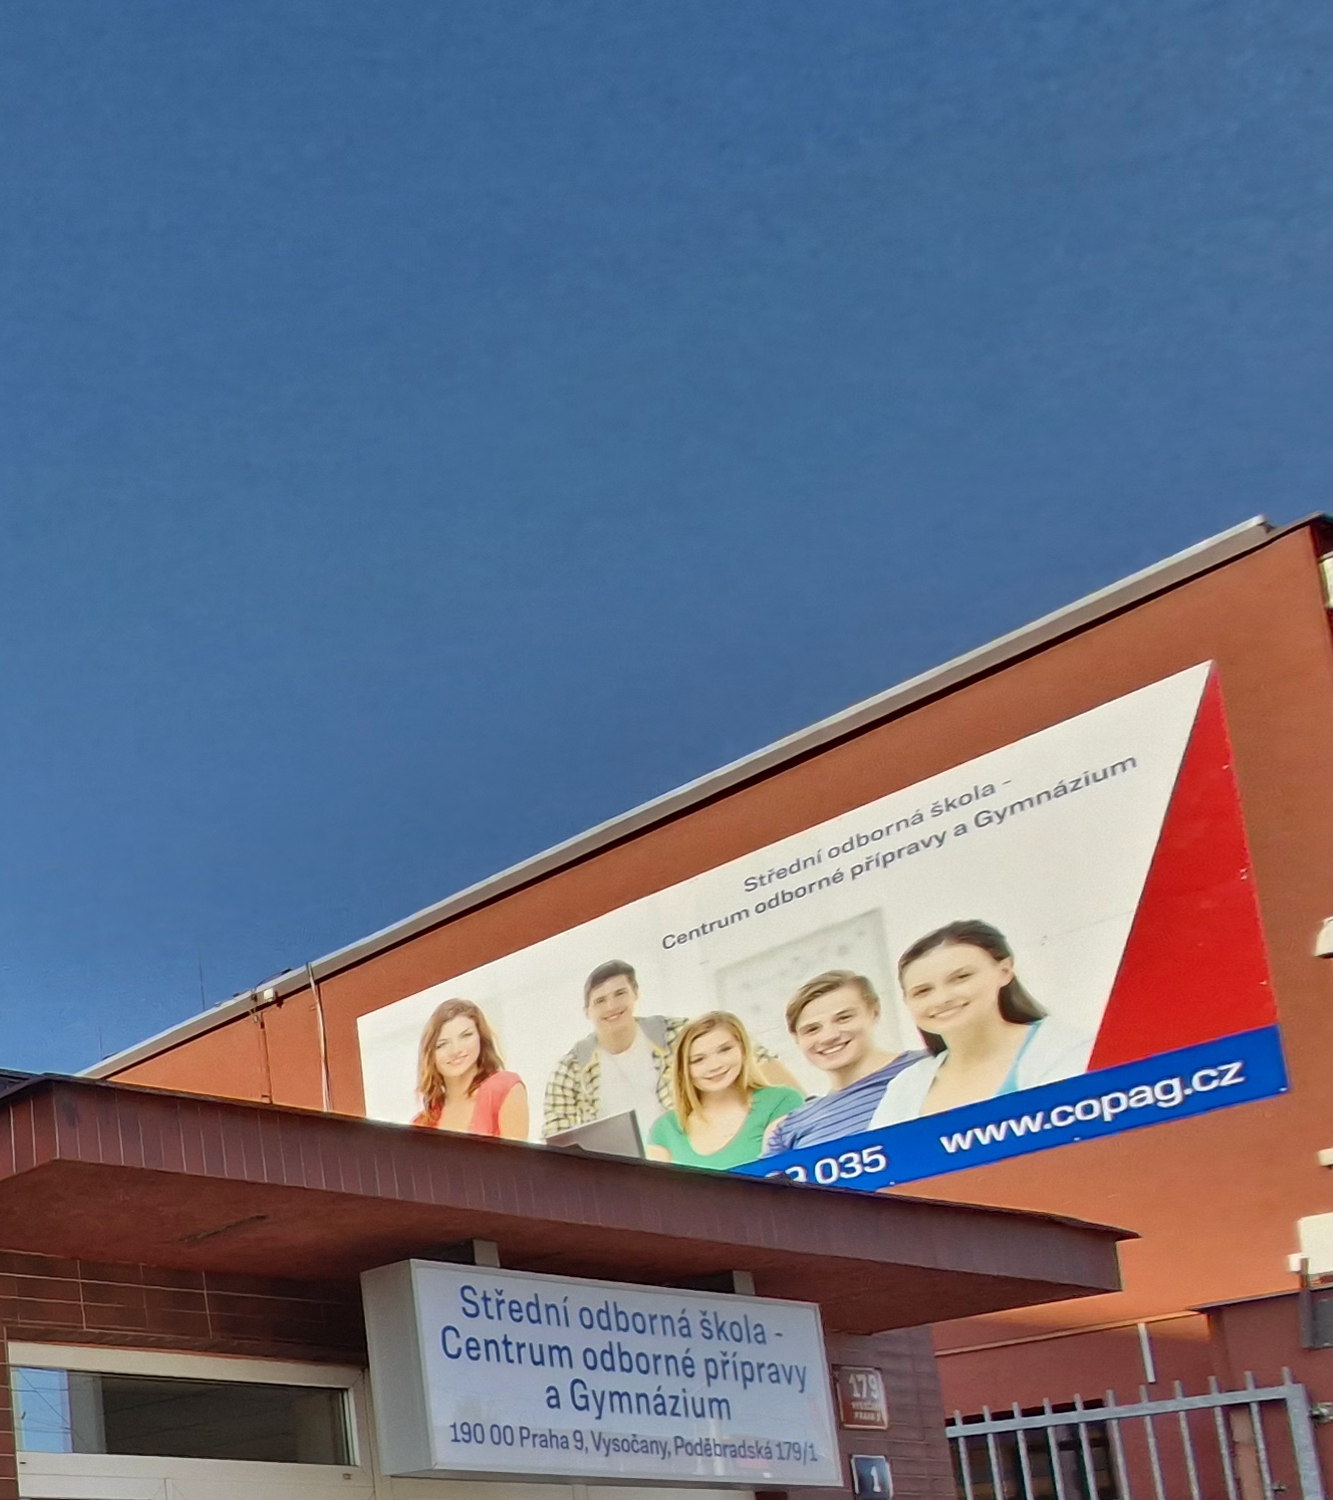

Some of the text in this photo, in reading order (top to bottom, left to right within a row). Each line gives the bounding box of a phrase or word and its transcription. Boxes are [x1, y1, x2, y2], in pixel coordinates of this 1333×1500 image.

[662, 755, 1137, 951] Centrum odborné přípravy a Gymnázium
[744, 848, 823, 893] Střední
[827, 808, 924, 860] odborná
[929, 778, 996, 819] škola
[814, 1145, 887, 1186] 035
[940, 1059, 1245, 1154] www.copag.cz
[460, 1285, 570, 1328] Střední
[579, 1302, 693, 1339] odborná
[700, 1310, 767, 1345] škola
[441, 1325, 807, 1393] Centrum odborné přípravy
[848, 1374, 879, 1399] 179
[545, 1378, 732, 1420] a Gymnázium
[450, 1422, 818, 1466] 190 00 Praha 9, Vysočany, Poděbradská 179/1
[870, 1466, 881, 1492] 1
